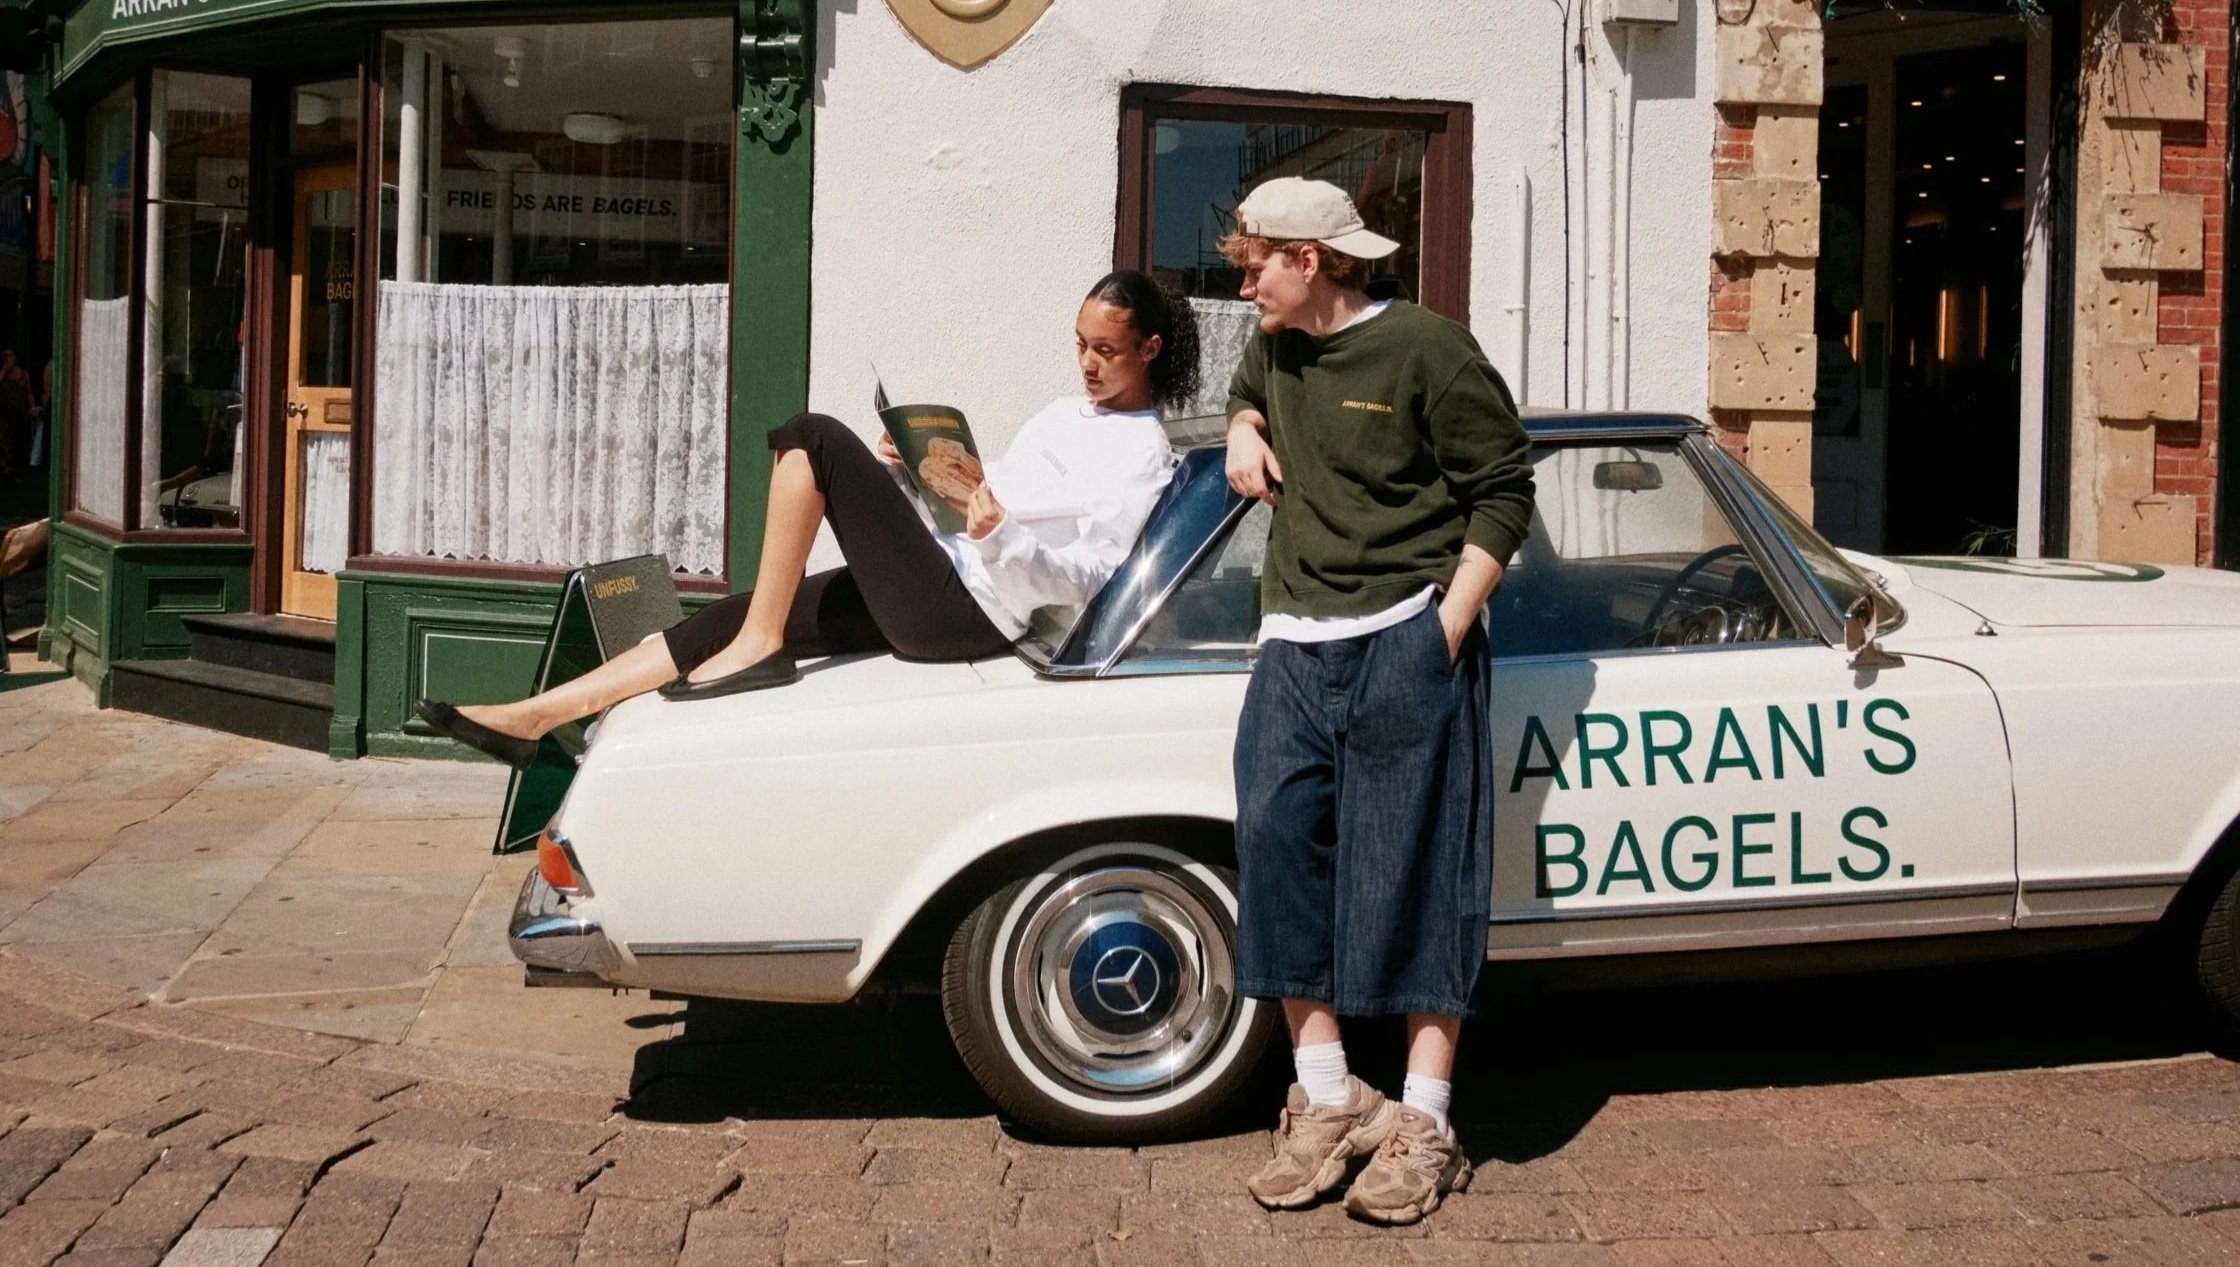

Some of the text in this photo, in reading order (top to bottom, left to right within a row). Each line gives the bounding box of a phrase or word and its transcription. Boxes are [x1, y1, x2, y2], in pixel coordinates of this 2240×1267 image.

[447, 190, 677, 217] FRIEDS ARE BAGELS.
[594, 575, 639, 599] UNFUSSY.
[1509, 698, 1917, 793] ARRAN'S
[1535, 806, 1915, 898] BAGELS.
